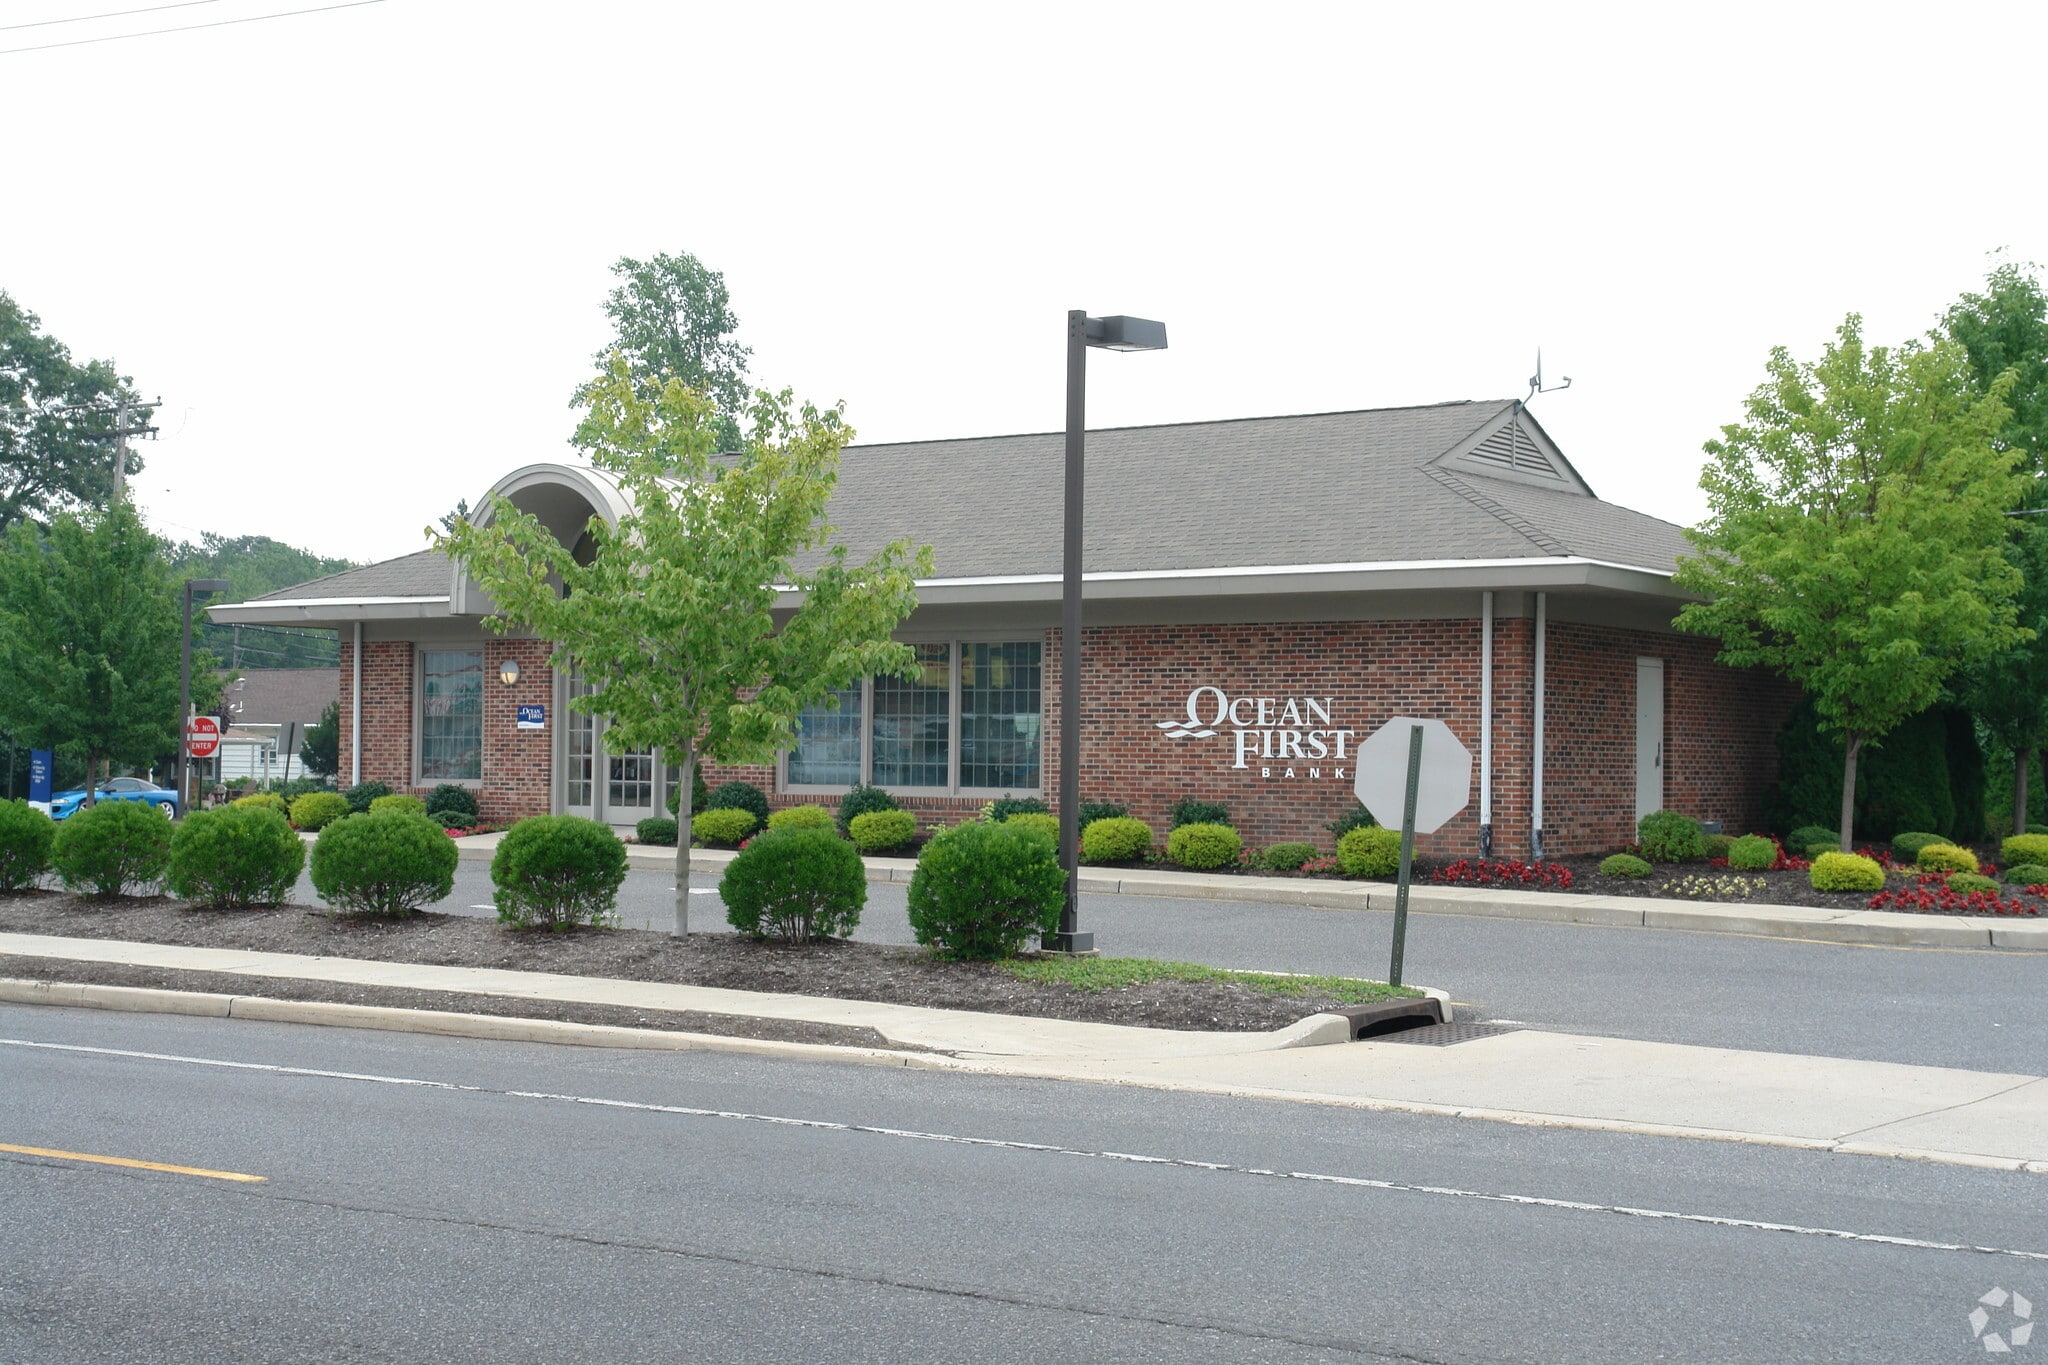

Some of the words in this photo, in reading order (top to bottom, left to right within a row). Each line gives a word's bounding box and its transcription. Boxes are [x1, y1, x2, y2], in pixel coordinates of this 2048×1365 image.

[1186, 686, 1334, 727] OCEAN
[1231, 729, 1355, 769] FIRST
[1261, 767, 1345, 779] BANK
